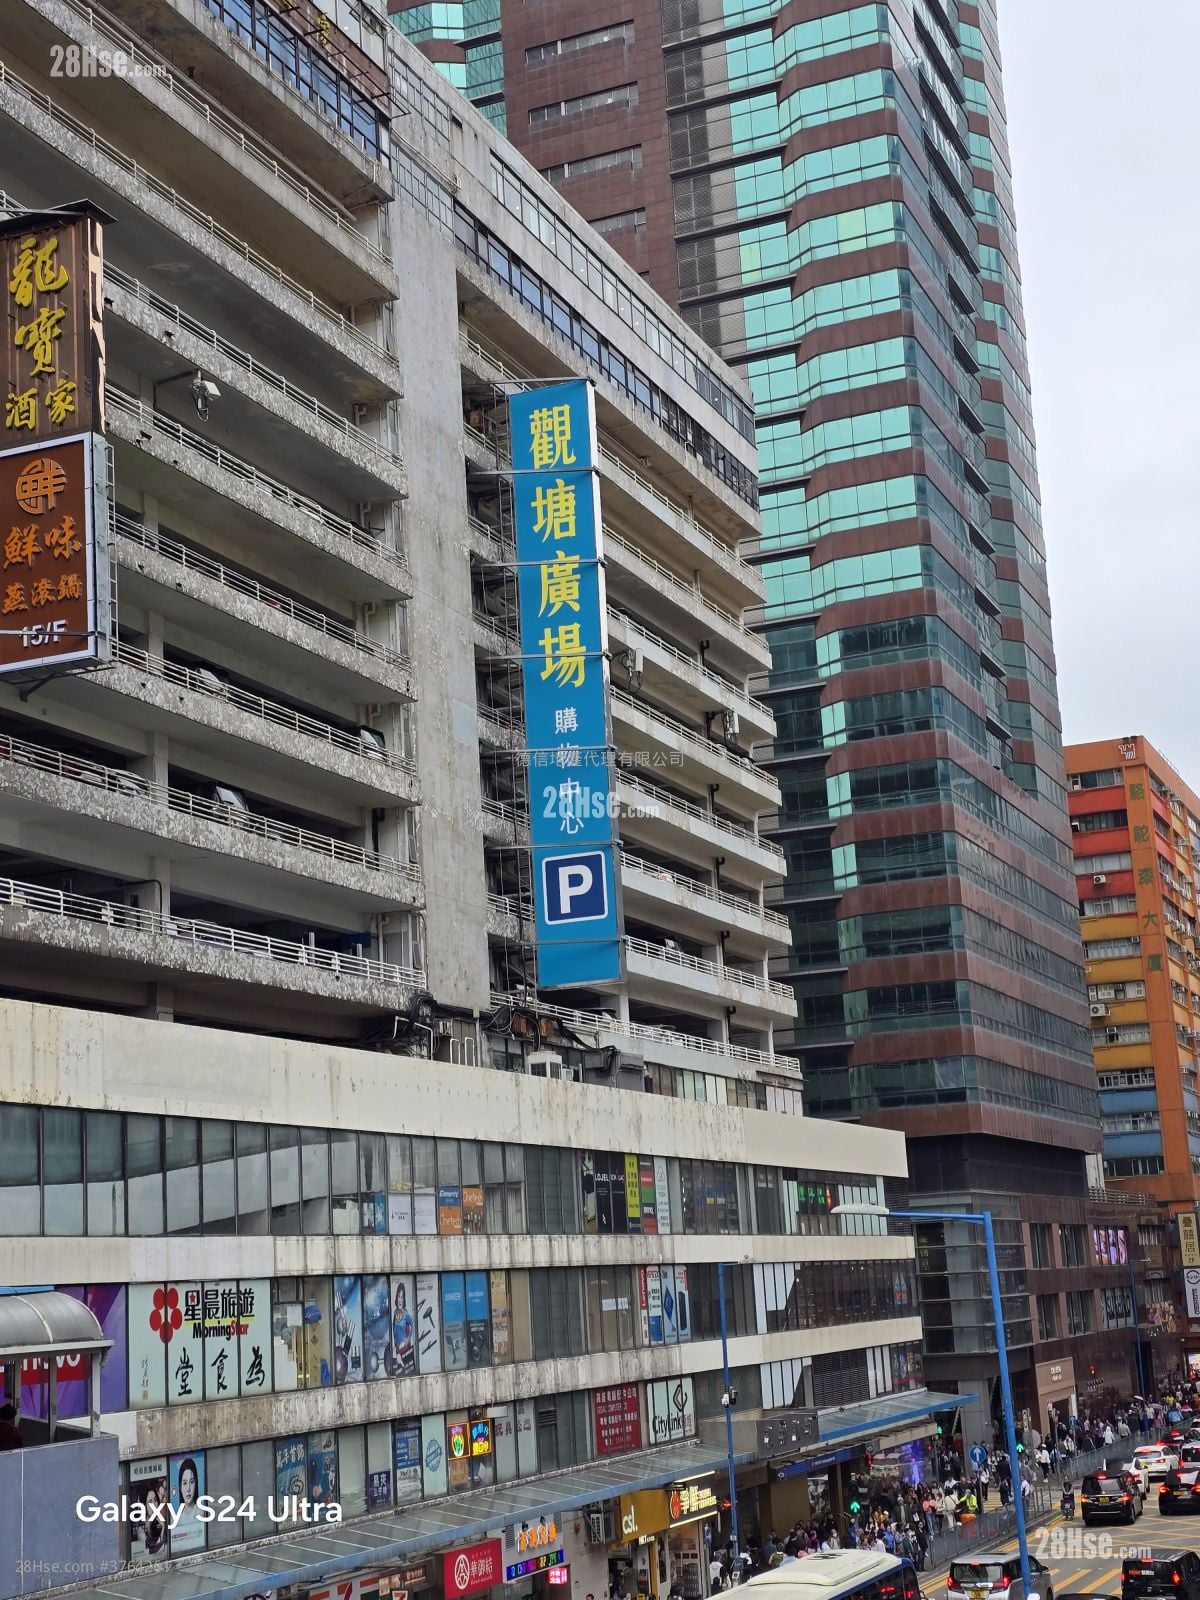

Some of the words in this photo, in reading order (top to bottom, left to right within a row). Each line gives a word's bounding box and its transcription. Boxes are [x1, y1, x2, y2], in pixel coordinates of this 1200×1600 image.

[5, 379, 77, 430] 酒家
[3, 515, 82, 568] 鮮味
[529, 404, 587, 688] 觀塘廣場
[20, 619, 67, 647] 15/F
[554, 707, 584, 834] 購物中心
[558, 865, 593, 914] P
[1129, 783, 1162, 971] 駱駝漆大廈
[184, 1287, 255, 1322] 星晨旅遊
[193, 1319, 249, 1341] MorningStar
[622, 1504, 638, 1535] csl.
